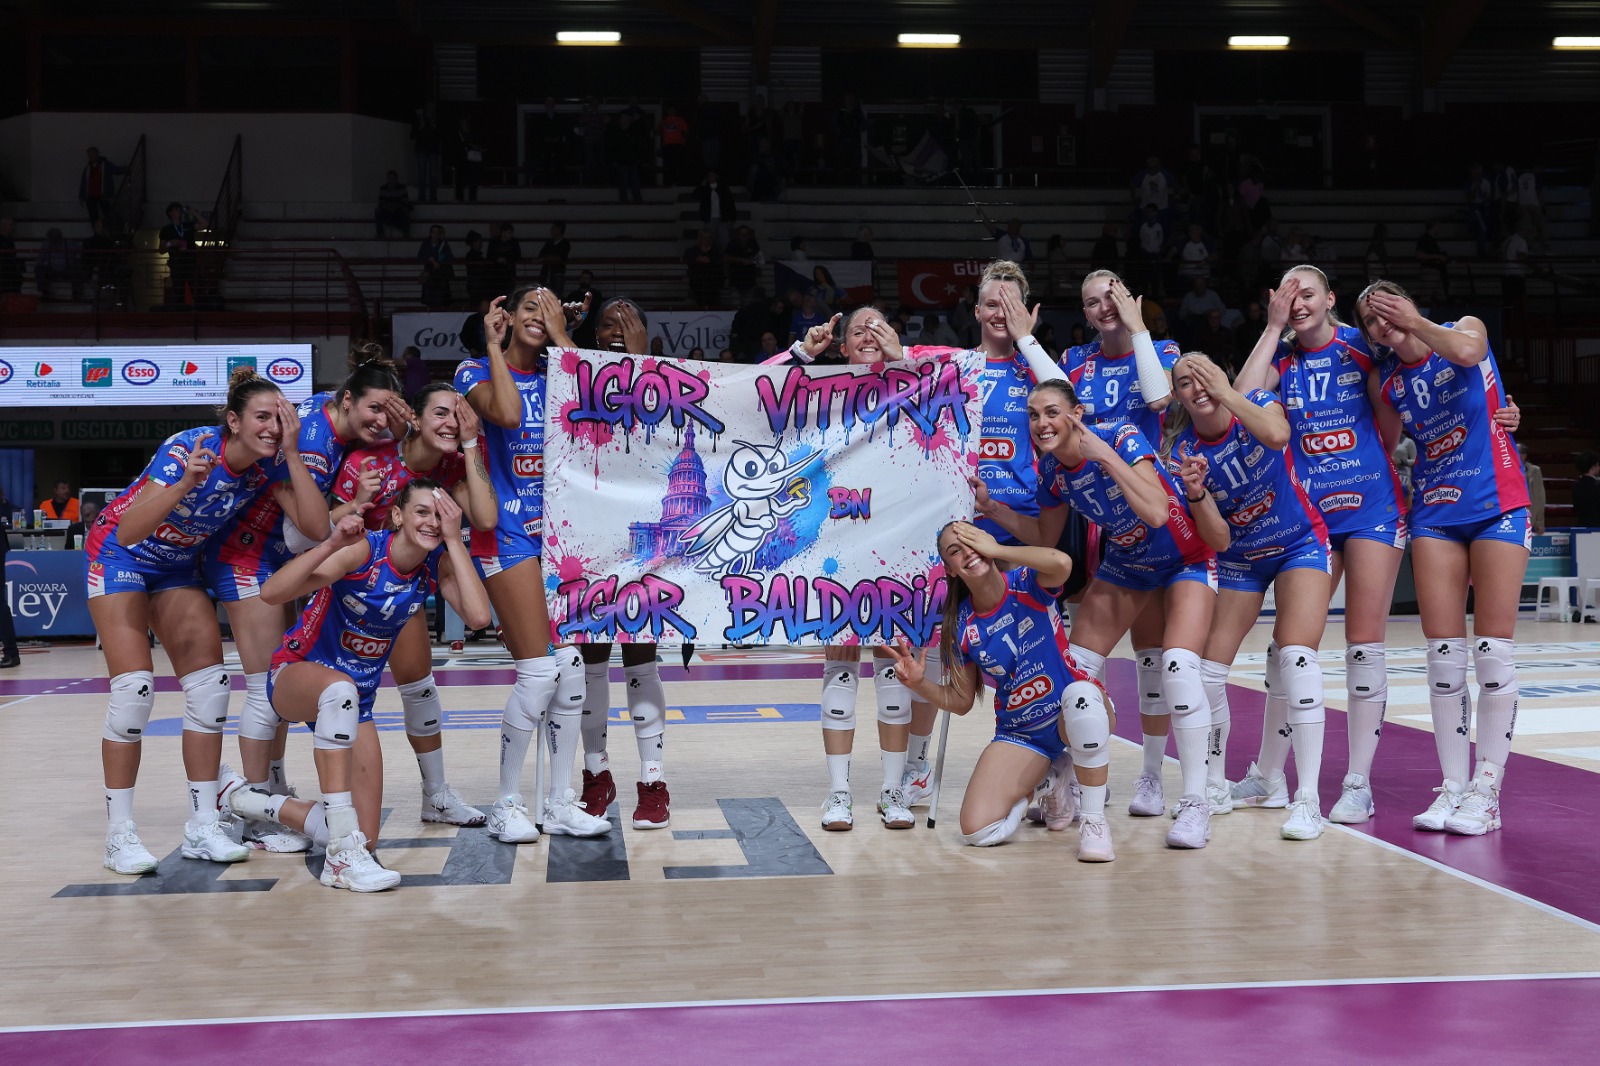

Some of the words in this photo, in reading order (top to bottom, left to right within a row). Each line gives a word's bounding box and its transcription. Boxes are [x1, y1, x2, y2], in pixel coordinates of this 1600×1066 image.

[26, 380, 61, 388] Retitalia
[172, 378, 206, 386] Retitalia
[1308, 372, 1330, 402] 17
[568, 357, 725, 438] IGOR
[983, 380, 998, 406] 7
[1104, 380, 1119, 407] 9
[1413, 379, 1430, 409] 8
[522, 392, 544, 421] 13
[1314, 408, 1343, 418] Retitalia
[66, 421, 127, 438] USCITA
[133, 421, 149, 438] DI
[982, 425, 1017, 434] onzola
[1296, 415, 1356, 432] Gorgonzola
[1305, 432, 1352, 451] IGOR
[996, 471, 1013, 479] BPM
[1221, 457, 1249, 489] 11
[1308, 463, 1340, 475] BANCO
[1341, 459, 1361, 470] BPM
[1313, 472, 1381, 490] ManpowerGroup
[988, 487, 1030, 495] owerGroup
[194, 492, 234, 517] 23
[827, 486, 872, 521] BN
[1083, 488, 1104, 516] 5
[1321, 495, 1360, 510] sterilgarda
[19, 584, 68, 592] NOVARA
[380, 596, 396, 620] 4
[558, 575, 697, 641] IGOR
[345, 635, 387, 654] IGOR
[1002, 633, 1018, 661] 1
[1011, 708, 1044, 724] BANCO
